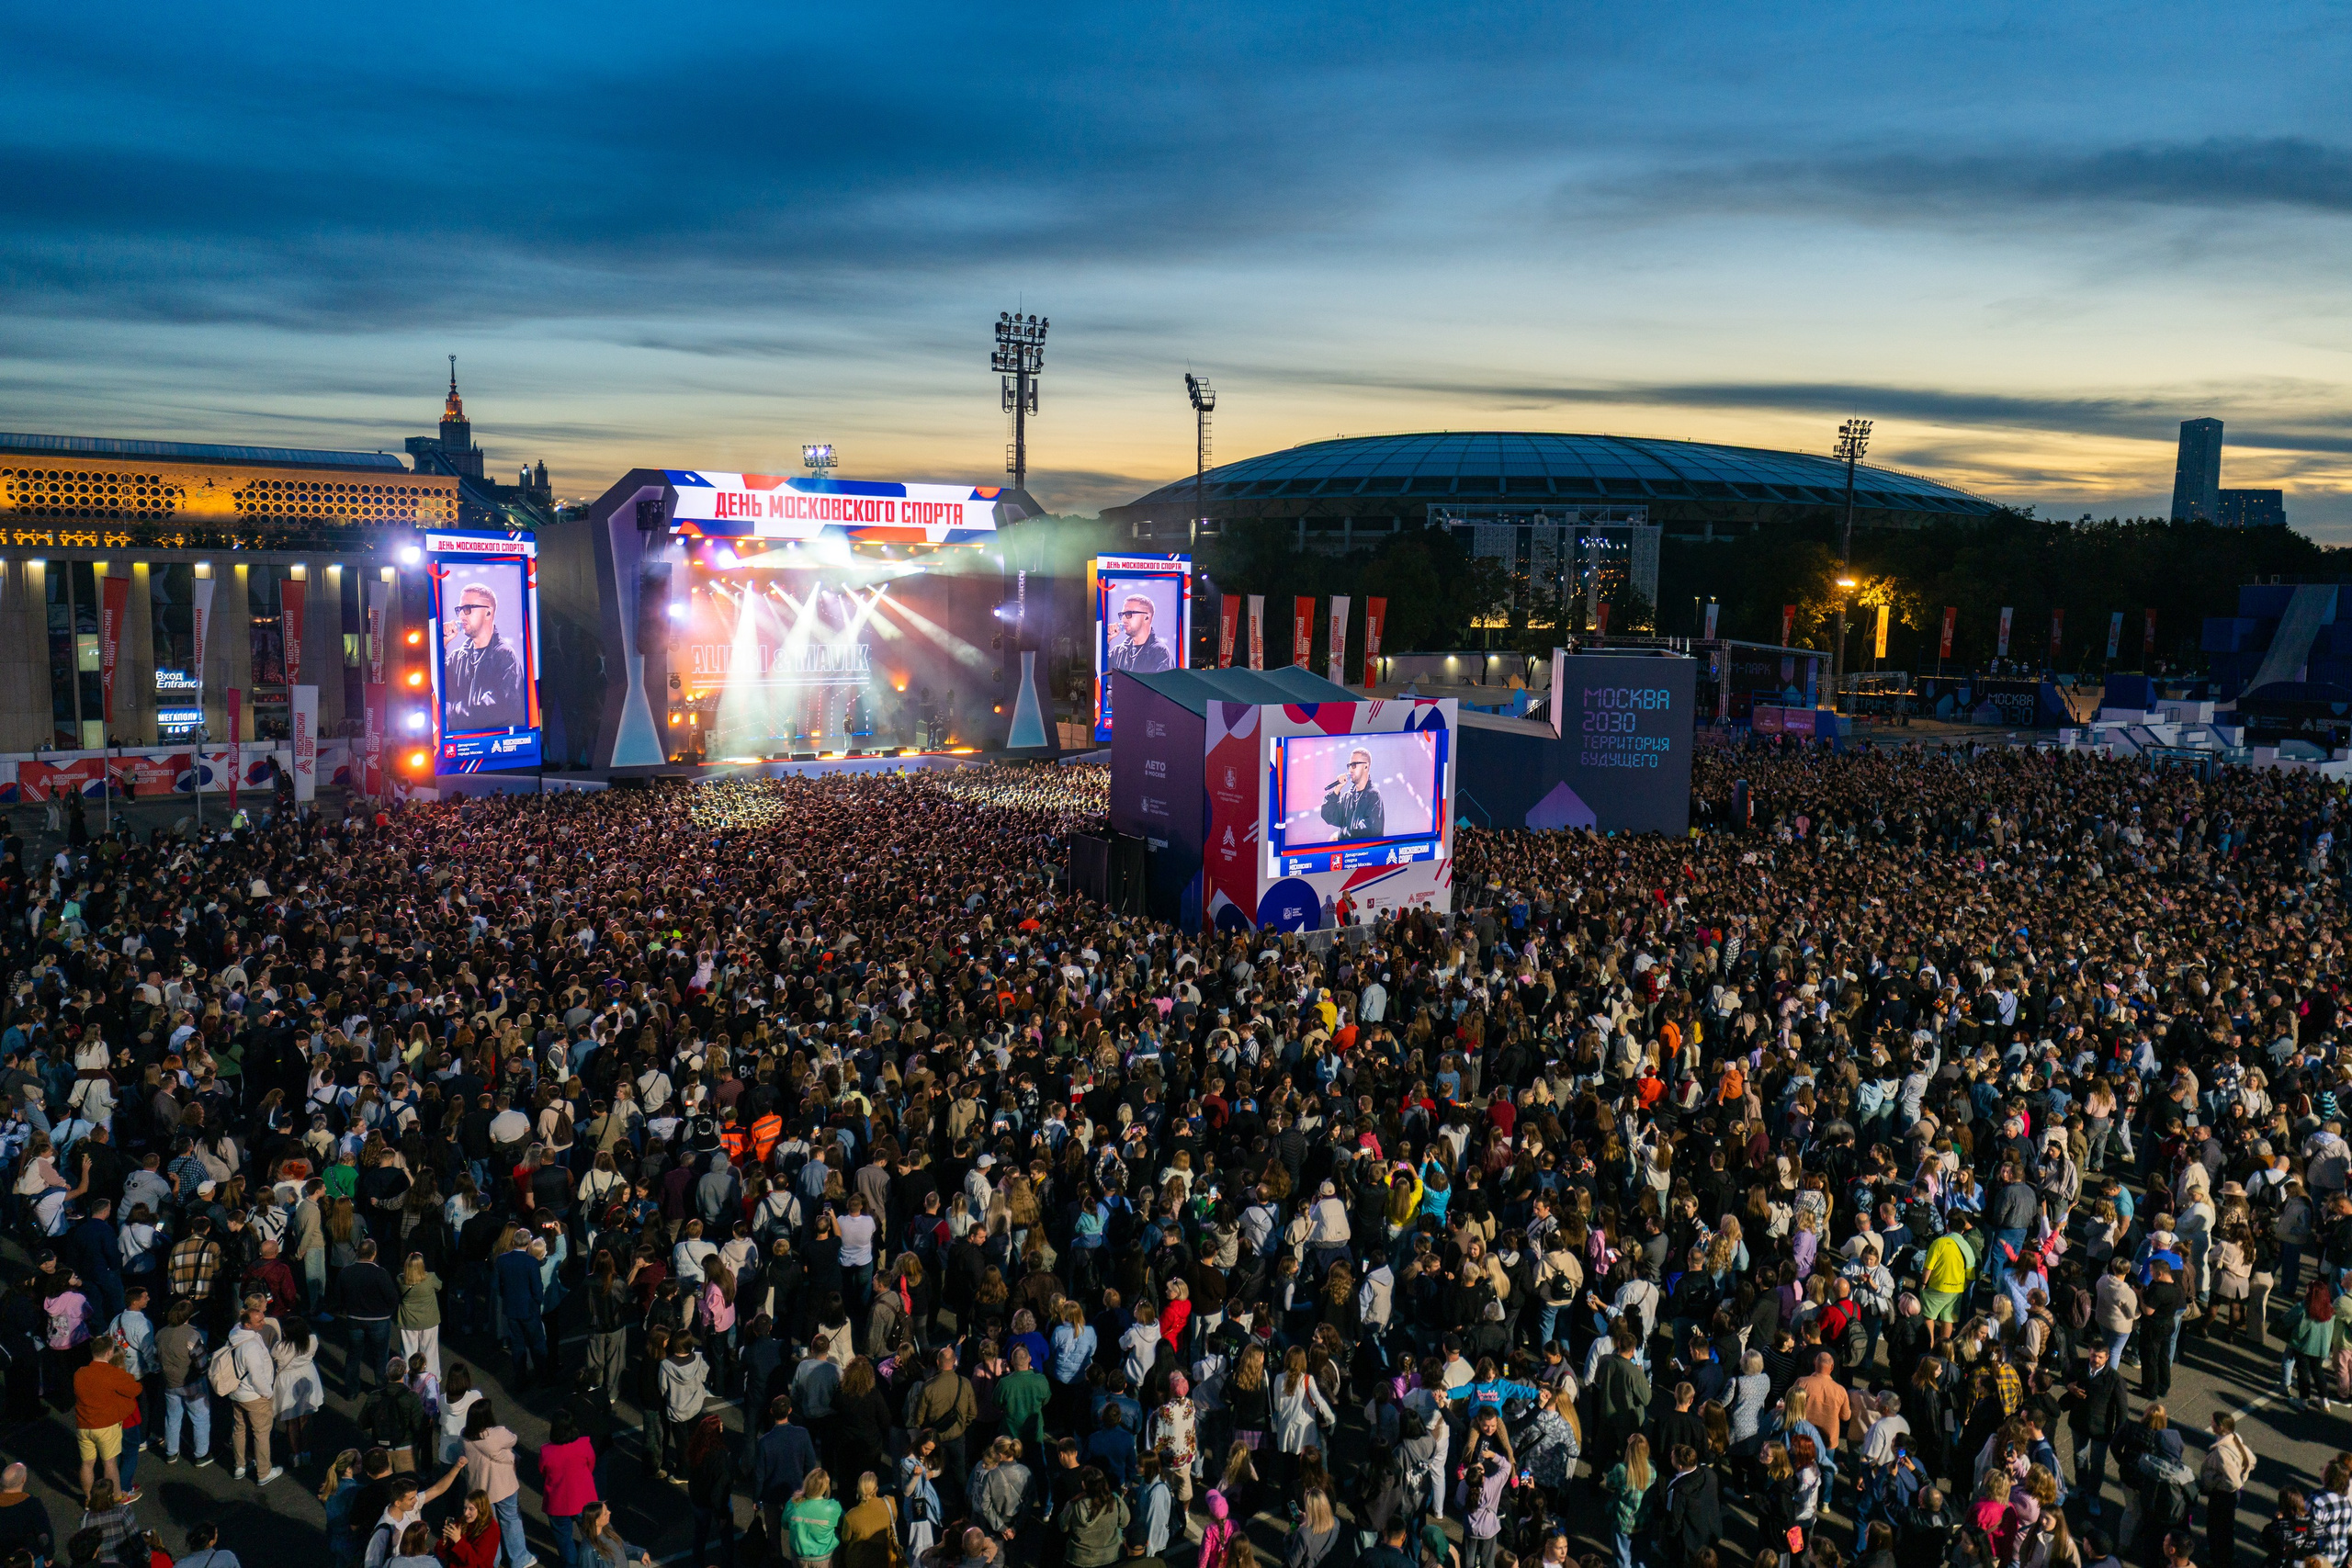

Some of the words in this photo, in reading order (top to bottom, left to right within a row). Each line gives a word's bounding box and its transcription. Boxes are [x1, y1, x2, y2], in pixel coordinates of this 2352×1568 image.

[715, 491, 762, 518] ДЕНЬ
[769, 494, 895, 523] МОСКОВСКОГО
[901, 501, 963, 525] СПОРТА
[438, 540, 454, 550] ДЕНЬ
[456, 541, 500, 551] МОСКОВСКОГО
[502, 543, 525, 552] СПОРТА
[1122, 561, 1159, 570] МОСКОВСКОГО
[284, 610, 294, 664] МОСКОВСКИЙ
[795, 644, 869, 672] MAVIK
[155, 671, 184, 682] Вход
[1583, 687, 1670, 710] МОСКВА
[1987, 693, 2034, 706] МОСКВА
[1582, 711, 1635, 733] 2030
[294, 712, 306, 757] МОСКОВСКИЙ
[371, 731, 380, 752] СПОРТ
[304, 736, 314, 757] СПОРТ
[1582, 735, 1670, 751] ТЕРРИТОРИЯ
[1145, 759, 1166, 772] ЛЕТО
[1580, 751, 1658, 769] БУДУЩЕГО
[52, 772, 88, 781] МОСКОВСКИЙ
[1148, 771, 1166, 779] МОСКВЕ
[1398, 843, 1430, 855] МОСКОВСКИЙ
[1398, 854, 1413, 864] СПОРТ
